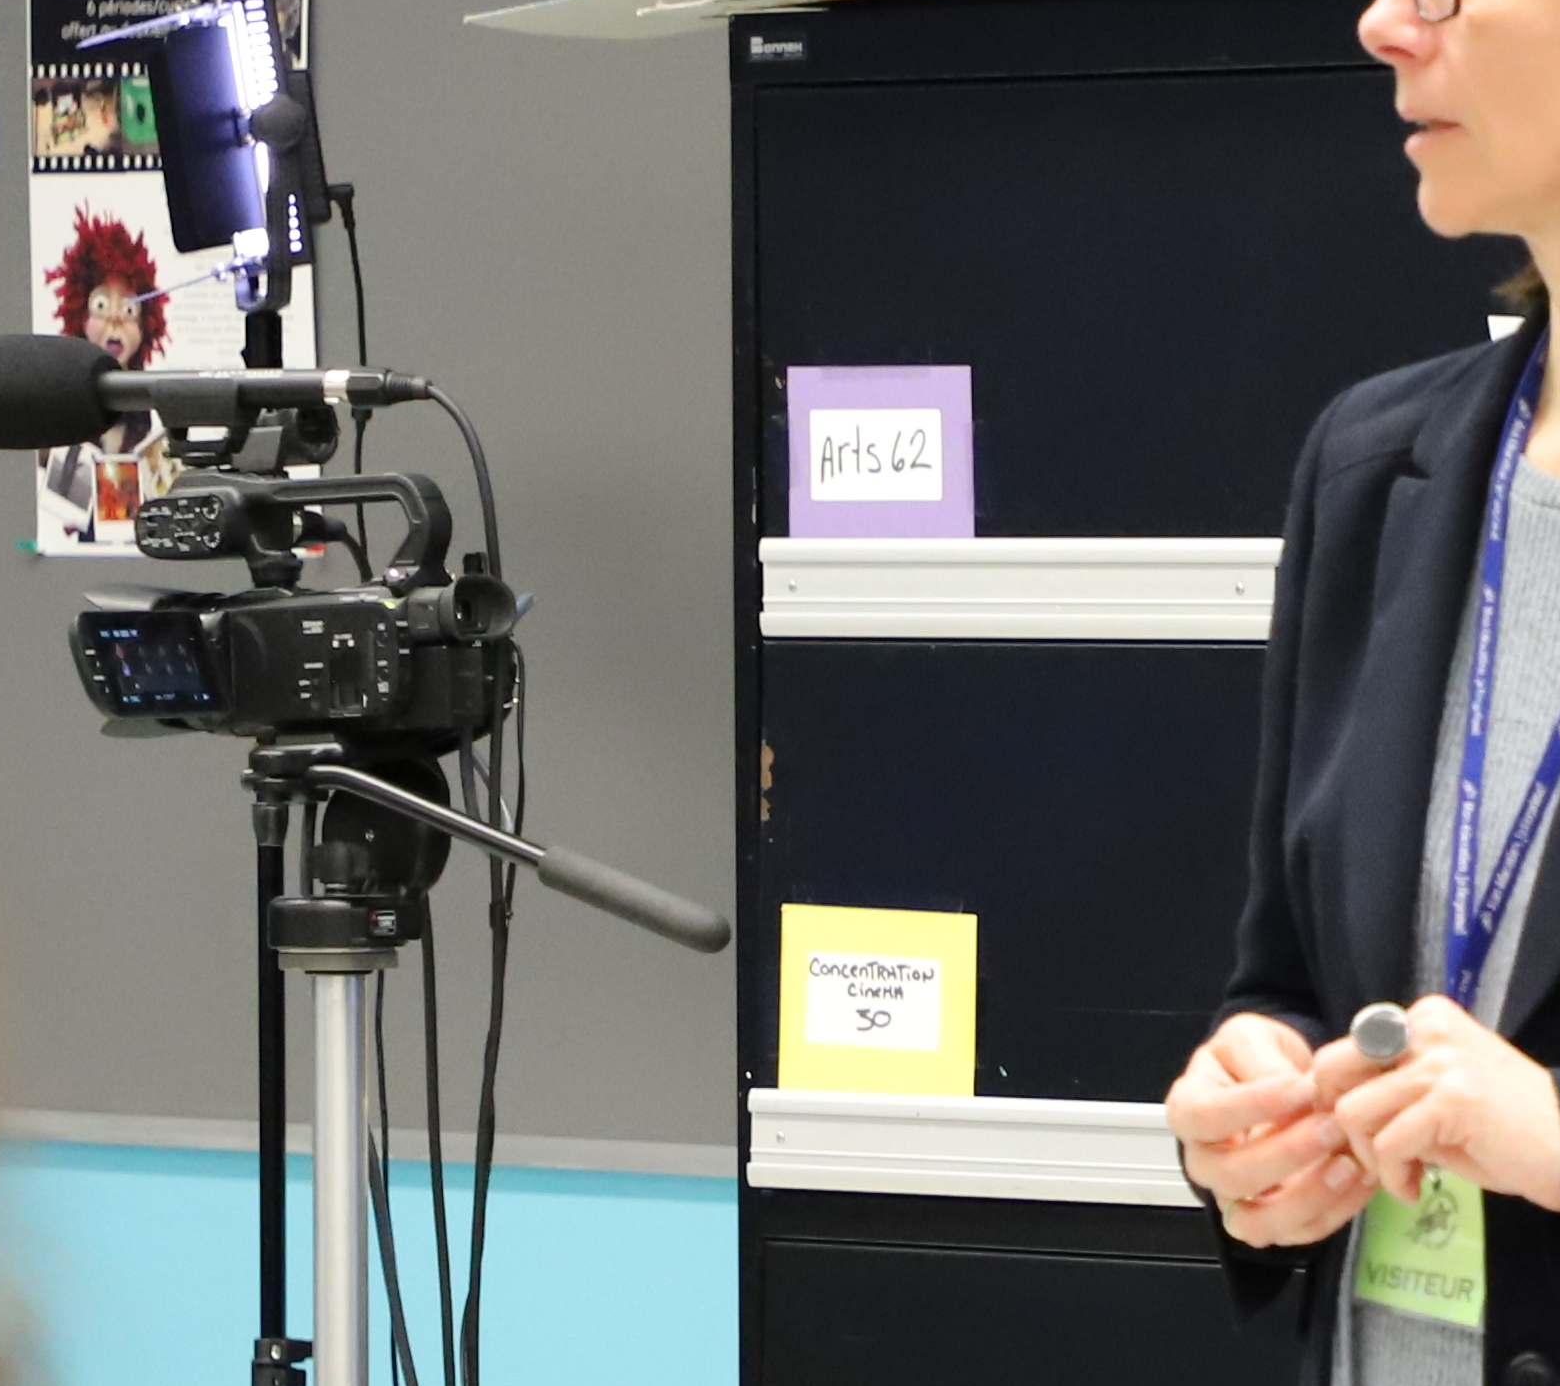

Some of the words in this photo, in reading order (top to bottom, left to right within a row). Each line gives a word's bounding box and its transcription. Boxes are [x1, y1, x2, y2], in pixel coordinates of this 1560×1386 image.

[821, 424, 881, 484] Arts
[891, 428, 932, 472] 62
[1366, 1261, 1474, 1302] VISITEUR
